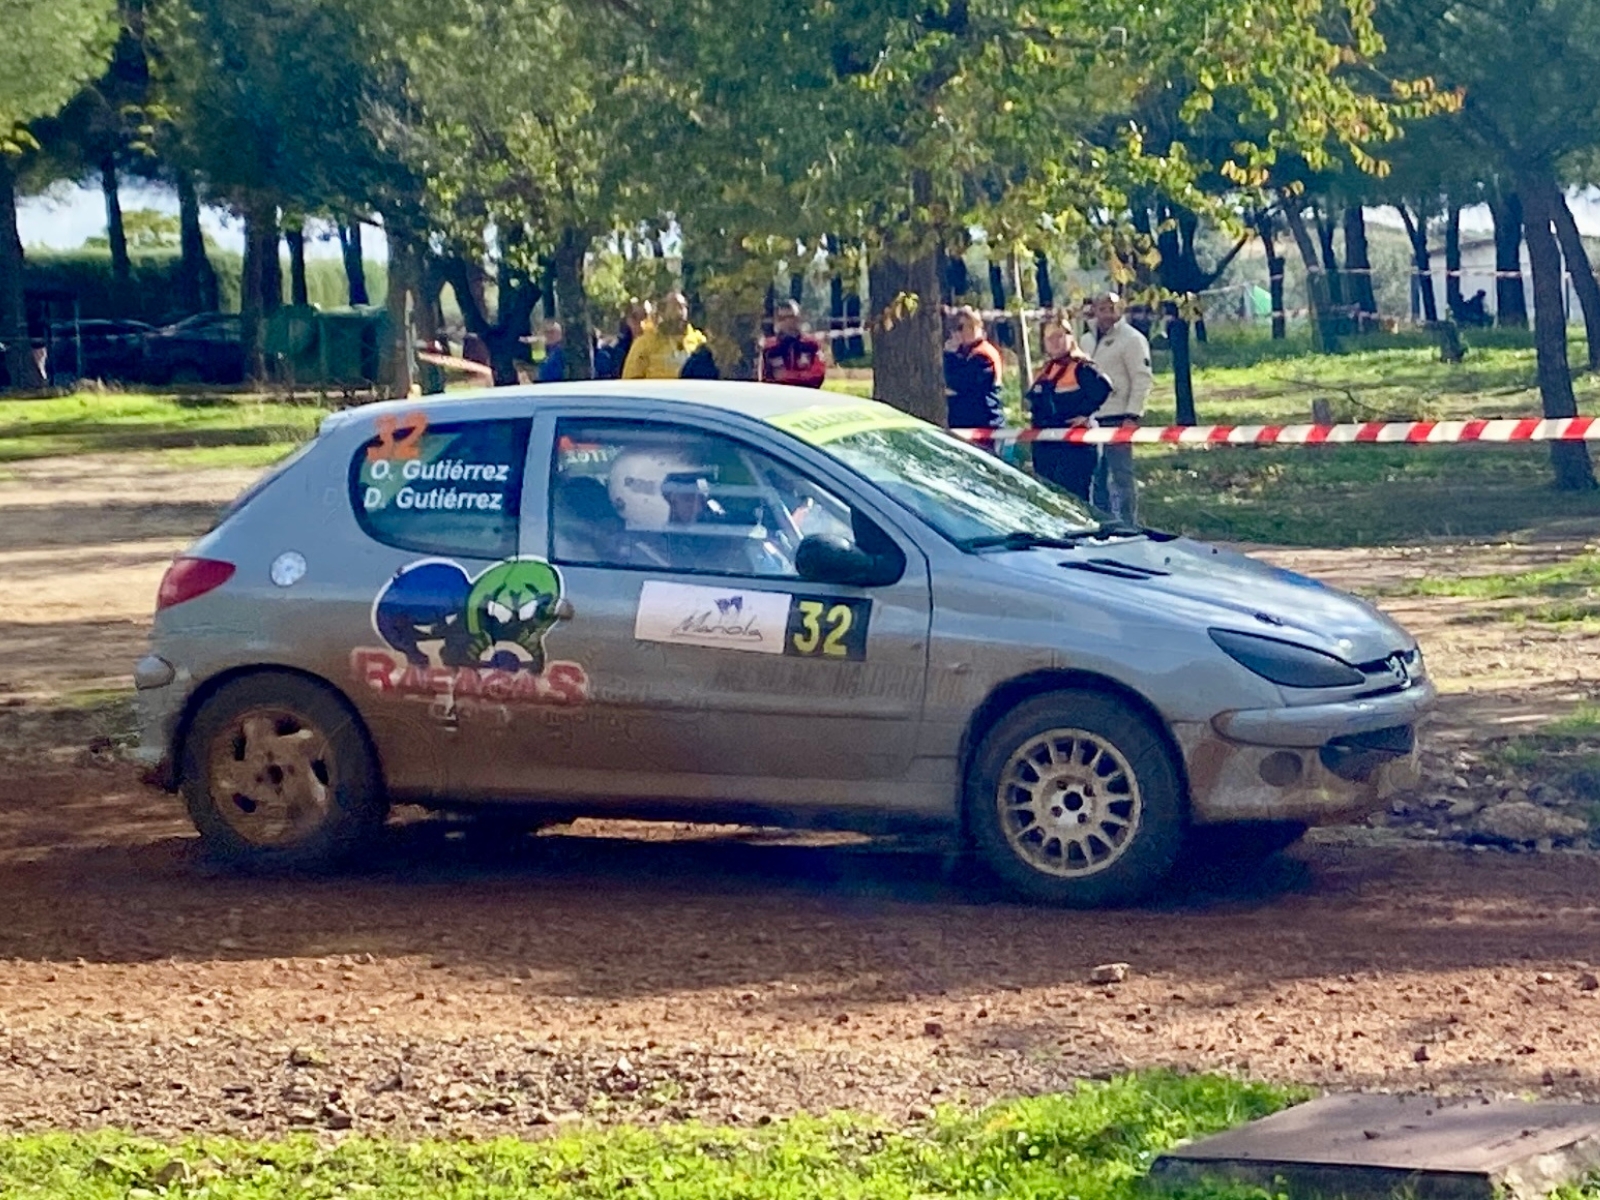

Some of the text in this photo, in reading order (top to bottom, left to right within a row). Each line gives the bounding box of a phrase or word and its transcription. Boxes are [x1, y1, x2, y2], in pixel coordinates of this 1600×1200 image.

[366, 411, 428, 461] 32
[370, 459, 510, 481] O. Gutiérrez
[364, 486, 503, 509] D. Gutiérrez
[792, 600, 853, 656] 32
